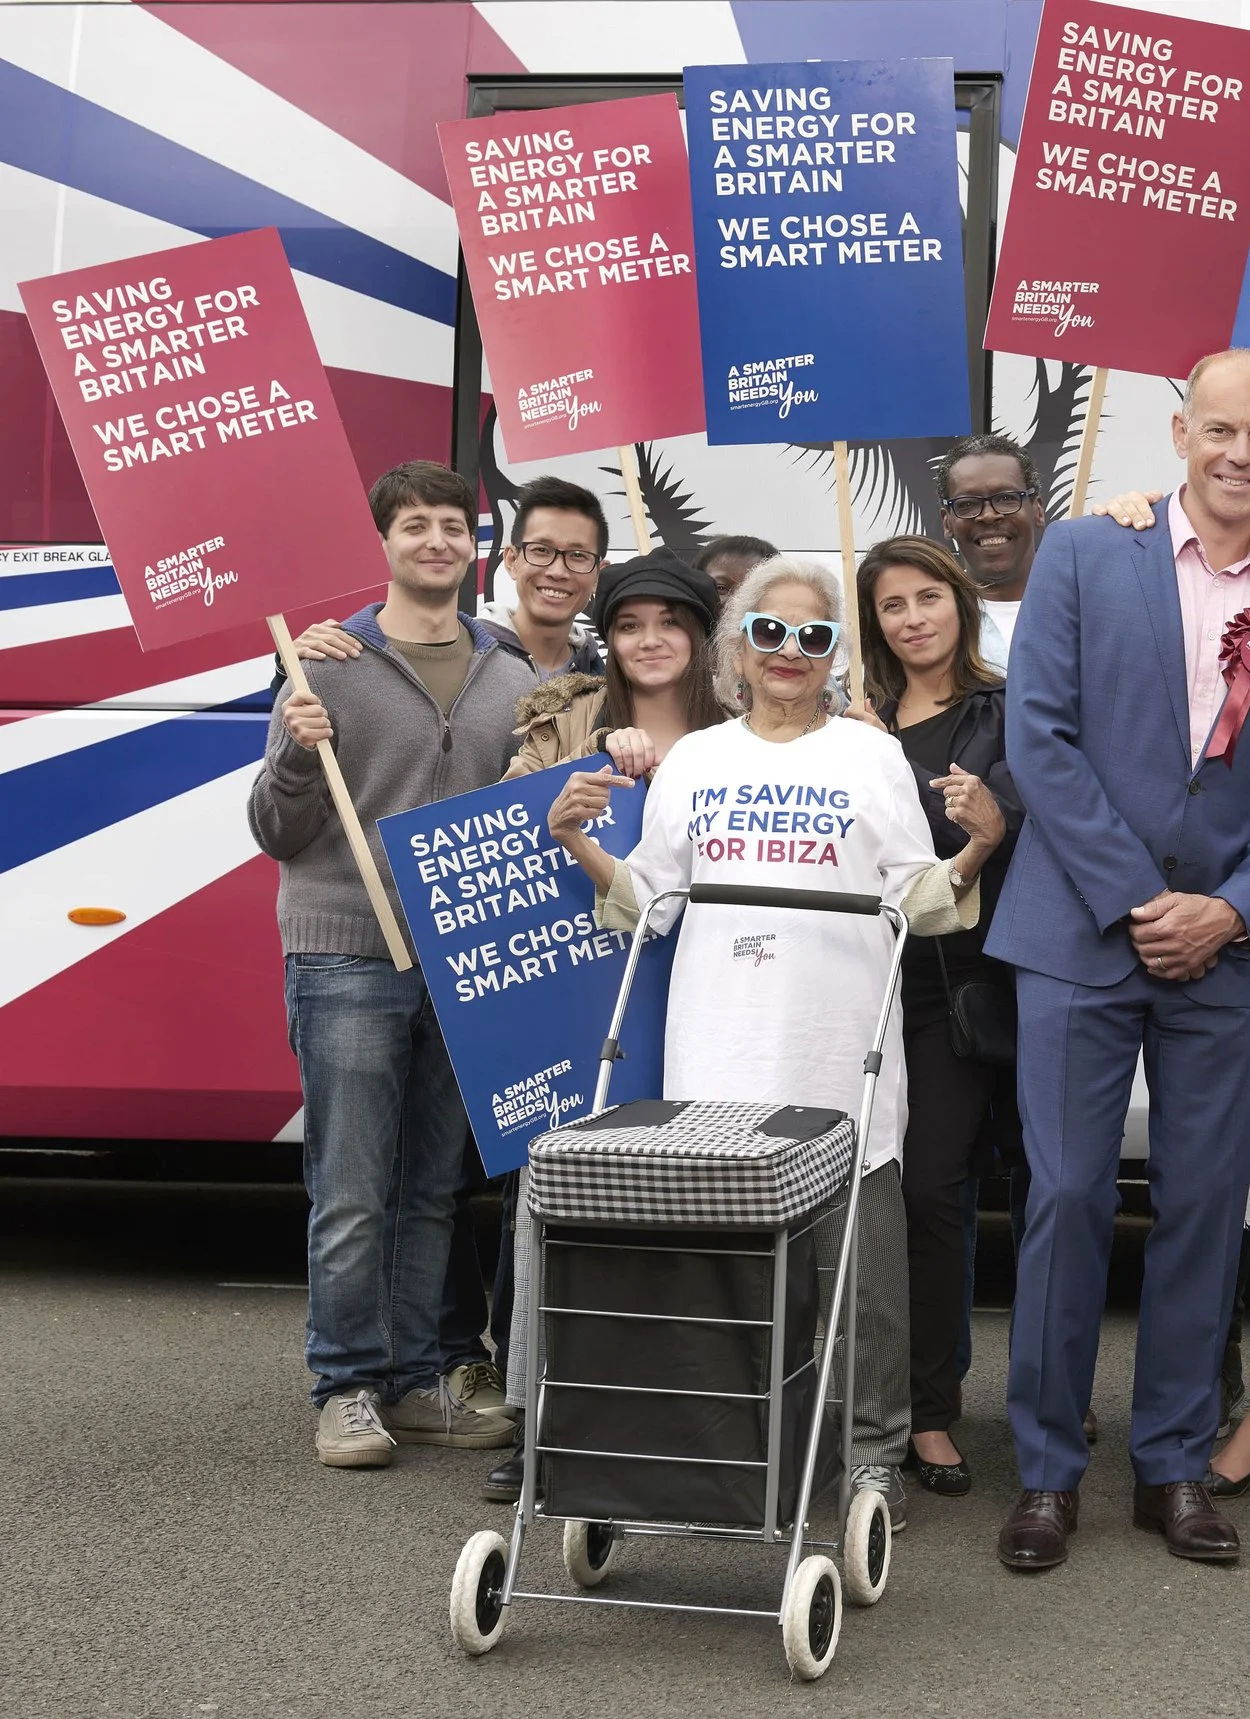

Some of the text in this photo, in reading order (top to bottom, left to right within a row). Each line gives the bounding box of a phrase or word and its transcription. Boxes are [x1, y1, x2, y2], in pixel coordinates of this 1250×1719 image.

[1062, 22, 1172, 61] SAVING
[1058, 48, 1242, 101] ENERGY FOR
[710, 87, 831, 113] SAVING
[1052, 74, 1218, 123] A SMARTER
[712, 112, 916, 141] ENERGY FOR
[1048, 99, 1165, 139] BRITAIN
[465, 130, 574, 163] SAVING
[470, 144, 652, 188] ENERGY FOR
[714, 140, 896, 168] A SMARTER
[716, 169, 843, 195] BRITAIN
[1043, 142, 1221, 193] WE CHOSE A
[477, 171, 638, 212] A SMARTER
[1036, 168, 1237, 221] SMART METER
[480, 201, 595, 236] BRITAIN
[717, 212, 920, 241] WE CHOSE A
[488, 233, 669, 276] WE CHOSE A
[720, 239, 942, 268] SMART METER
[494, 254, 691, 301] SMART METER
[52, 277, 172, 323] SAVING
[60, 285, 260, 350] ENERGY FOR
[74, 316, 248, 377] A SMARTER
[728, 354, 814, 378] A SMARTER
[78, 352, 206, 403] BRITAIN
[728, 370, 787, 390] BRITAIN
[92, 380, 291, 445] WE CHOSE A
[729, 381, 818, 419] NEEDS You
[103, 400, 318, 471] SMART METER
[13, 552, 39, 562] EXIT
[43, 552, 84, 562] BREAK
[145, 536, 225, 579] A SMARTER
[146, 558, 204, 591] BRITAIN
[150, 567, 238, 606] NEEDS You
[692, 784, 850, 812] I'M SAVING
[410, 804, 529, 856] SAVING
[687, 810, 855, 841] MY ENERGY
[418, 825, 540, 883] ENERGY
[757, 839, 839, 867] IBIZA
[430, 885, 452, 910] A
[434, 877, 559, 935] BRITAIN
[733, 941, 762, 951] BRITAIN
[733, 947, 776, 968] NEEDS You
[740, 933, 777, 944] SMARTER
[446, 942, 501, 976] WE
[456, 930, 670, 1002] SMART MET
[492, 1060, 572, 1106] A SMARTER
[493, 1083, 550, 1118] BRITAIN
[497, 1091, 584, 1130] NEEDS You
[501, 1112, 547, 1137] smartenergyGB.org
